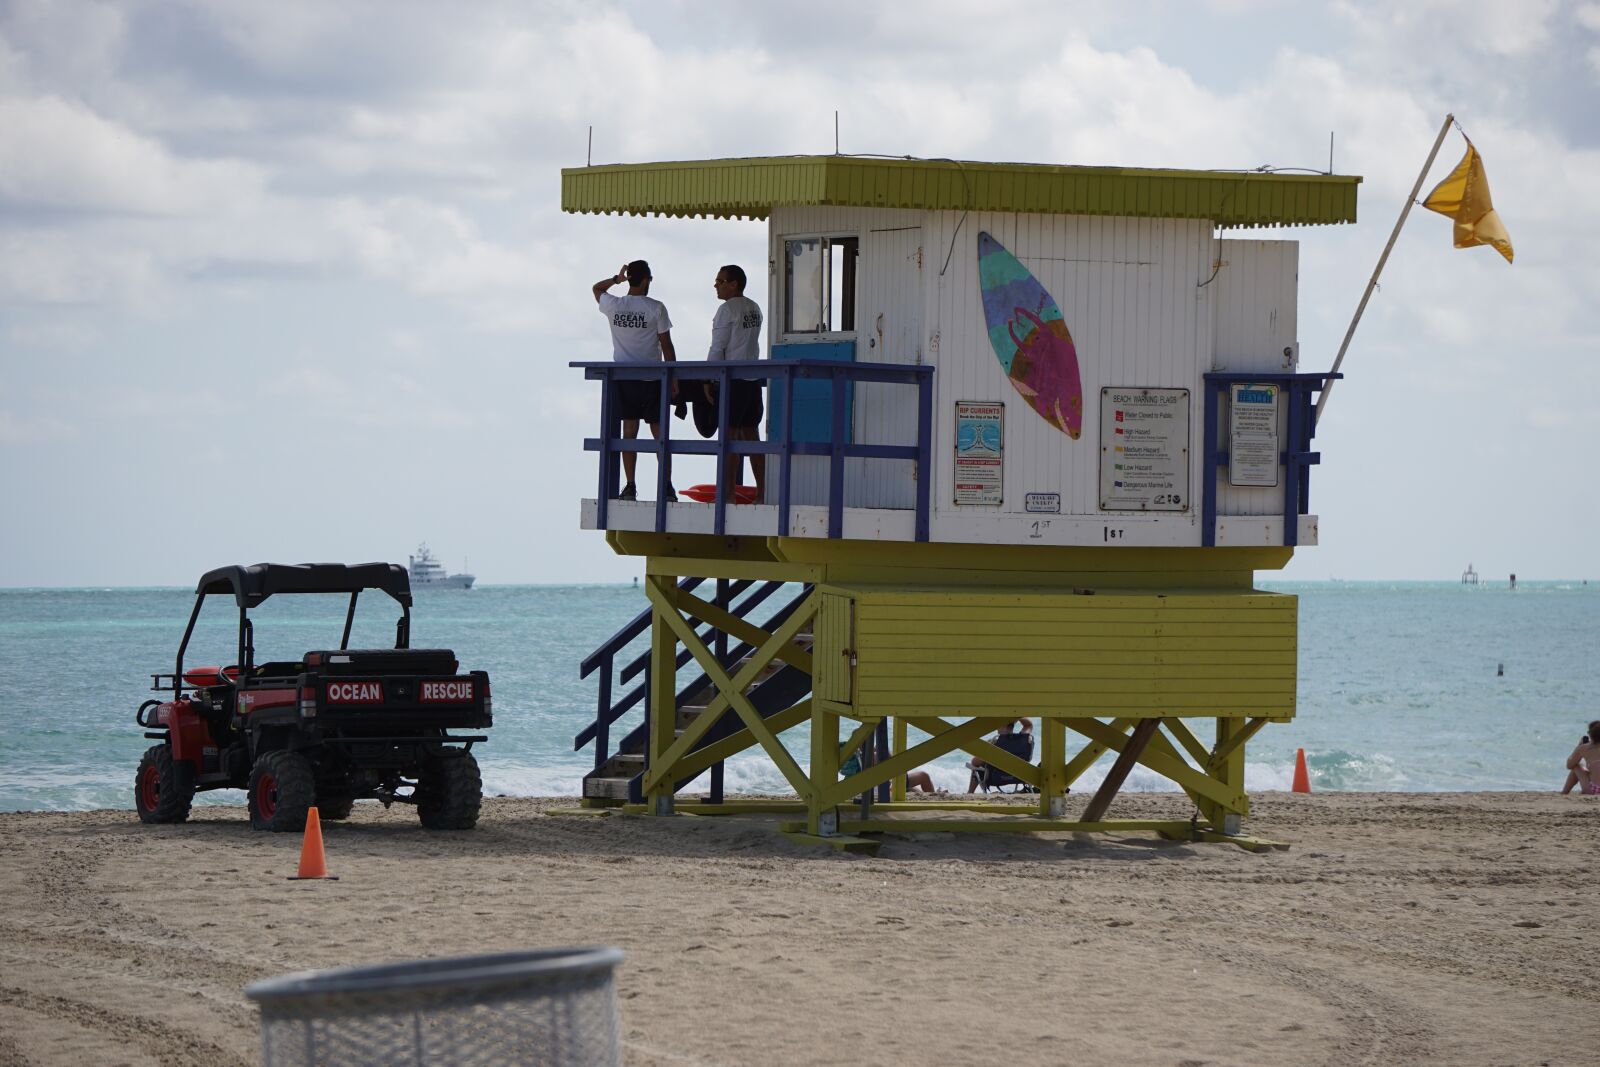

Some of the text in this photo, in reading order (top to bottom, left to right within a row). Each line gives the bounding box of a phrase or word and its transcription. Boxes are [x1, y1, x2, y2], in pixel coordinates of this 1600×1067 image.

[614, 313, 645, 322] OCEAN
[613, 319, 648, 329] RESCUE
[1113, 394, 1177, 404] BEACH WARNING FLAGS
[970, 407, 1000, 415] CURRENTS
[1124, 481, 1148, 489] Dangerous
[330, 683, 473, 700] OCEAN RESCUE
